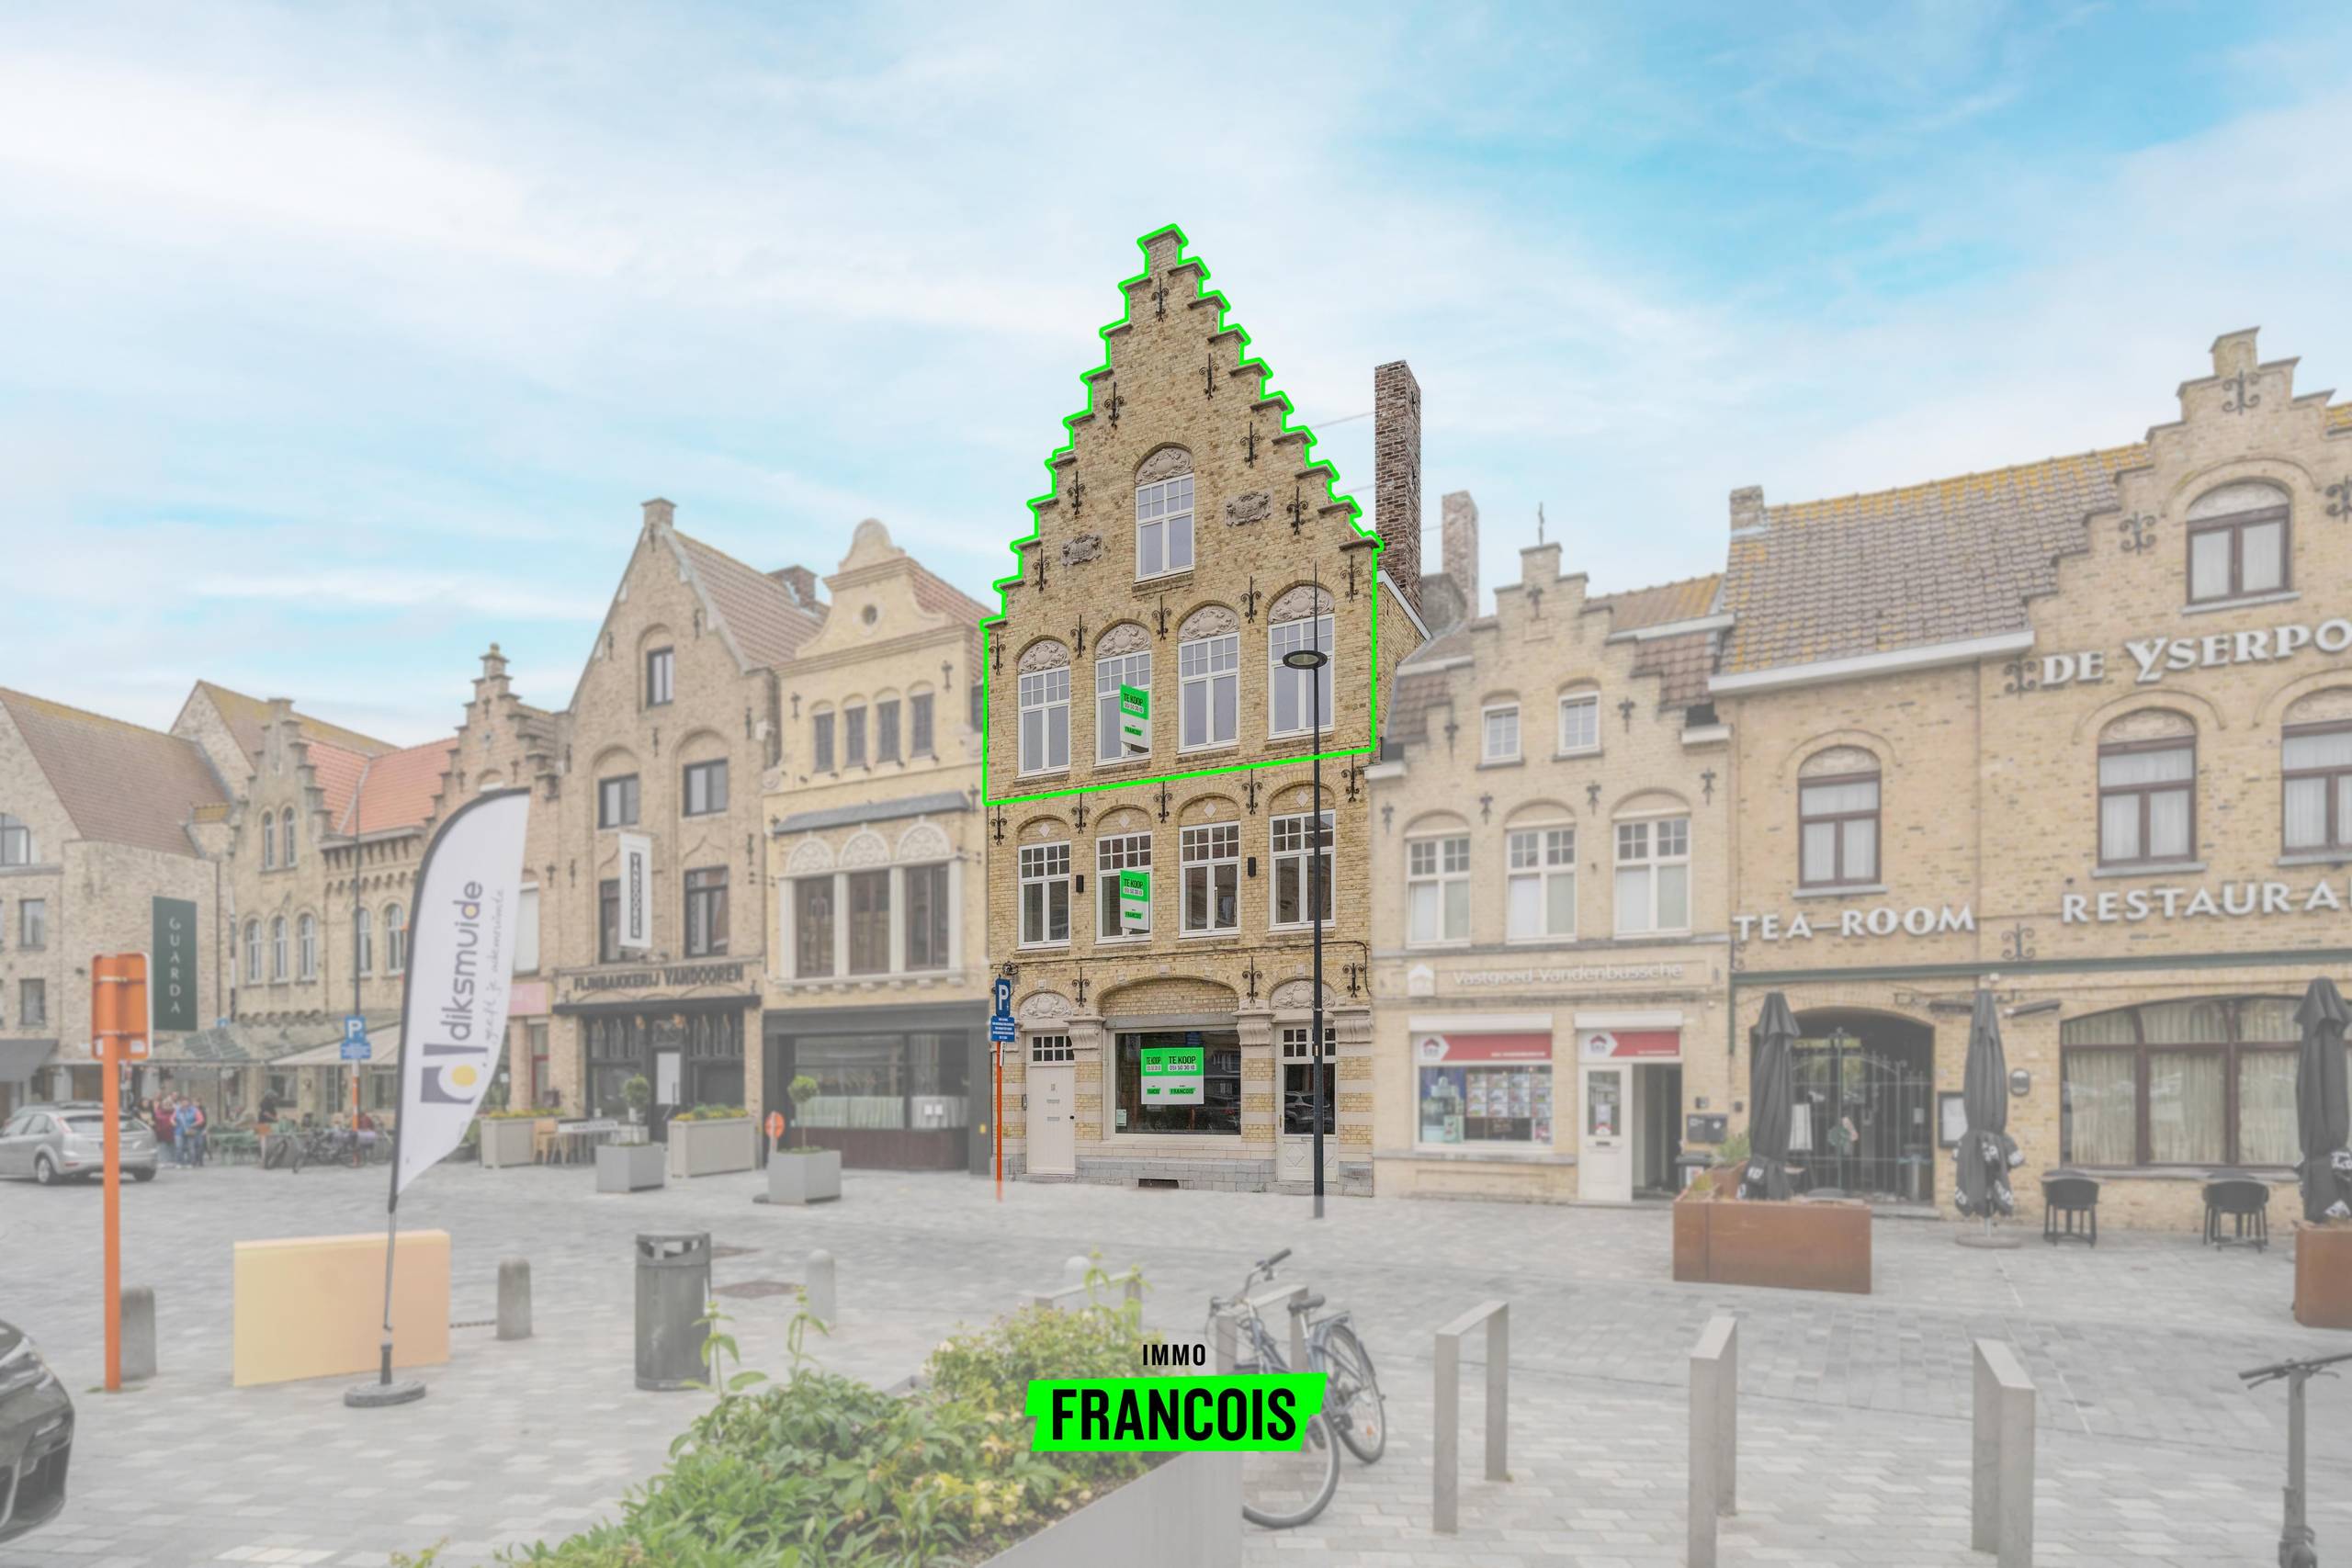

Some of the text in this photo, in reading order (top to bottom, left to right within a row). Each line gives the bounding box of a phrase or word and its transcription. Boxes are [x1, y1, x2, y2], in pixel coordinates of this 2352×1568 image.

[2041, 618, 2352, 685] DE YSERPO
[1124, 878, 1143, 889] TE KOOP
[2063, 879, 2352, 923] RESTAURA
[169, 917, 182, 1014] GUARDA
[440, 881, 483, 1041] diksmuide
[663, 964, 744, 986] VANDOOREN
[1453, 963, 1684, 986] Vastgoed Vandenbussche
[998, 984, 1009, 1010] P
[348, 1020, 363, 1039] P
